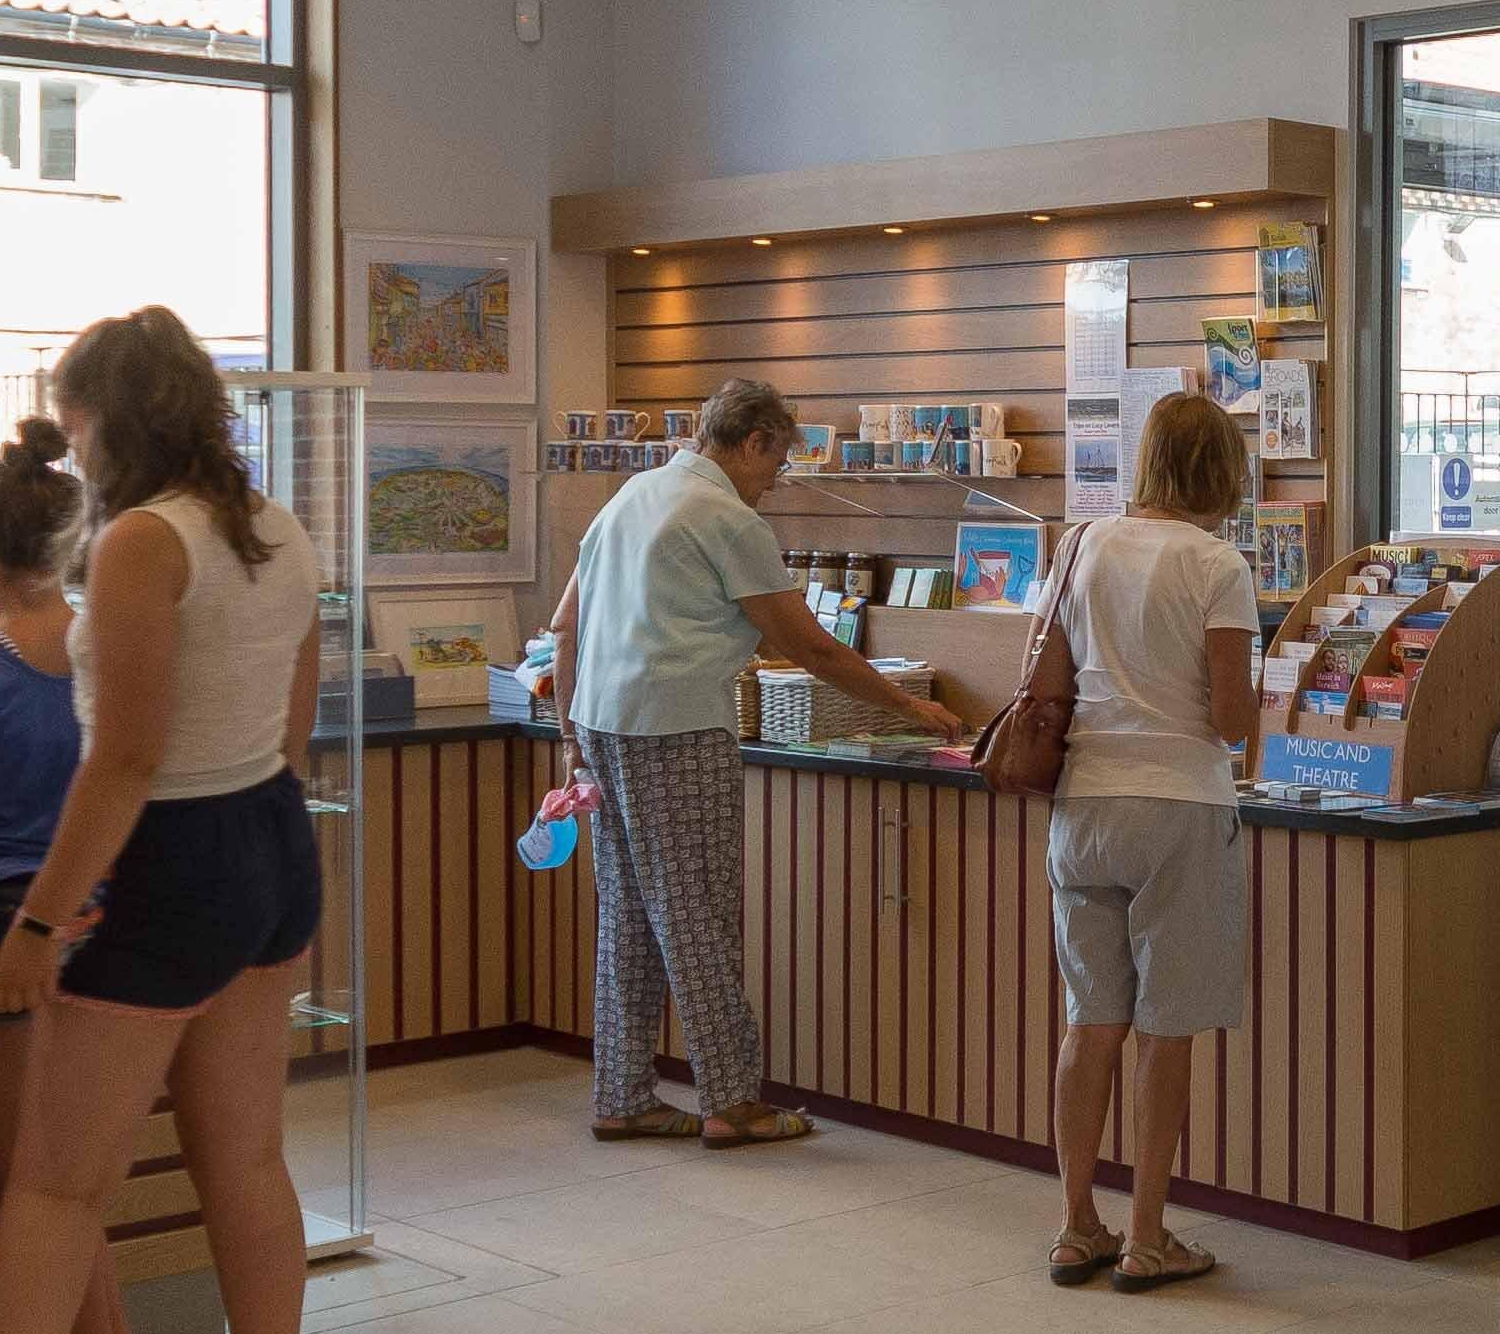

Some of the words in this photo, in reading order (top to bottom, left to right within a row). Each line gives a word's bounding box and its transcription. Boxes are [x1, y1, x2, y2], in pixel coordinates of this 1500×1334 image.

[1442, 513, 1457, 523] Keep
[1457, 513, 1471, 522] clear
[1483, 507, 1499, 515] door
[1286, 738, 1332, 759] MUSIC
[1334, 745, 1371, 763] AND
[1293, 765, 1359, 789] THEATRE
